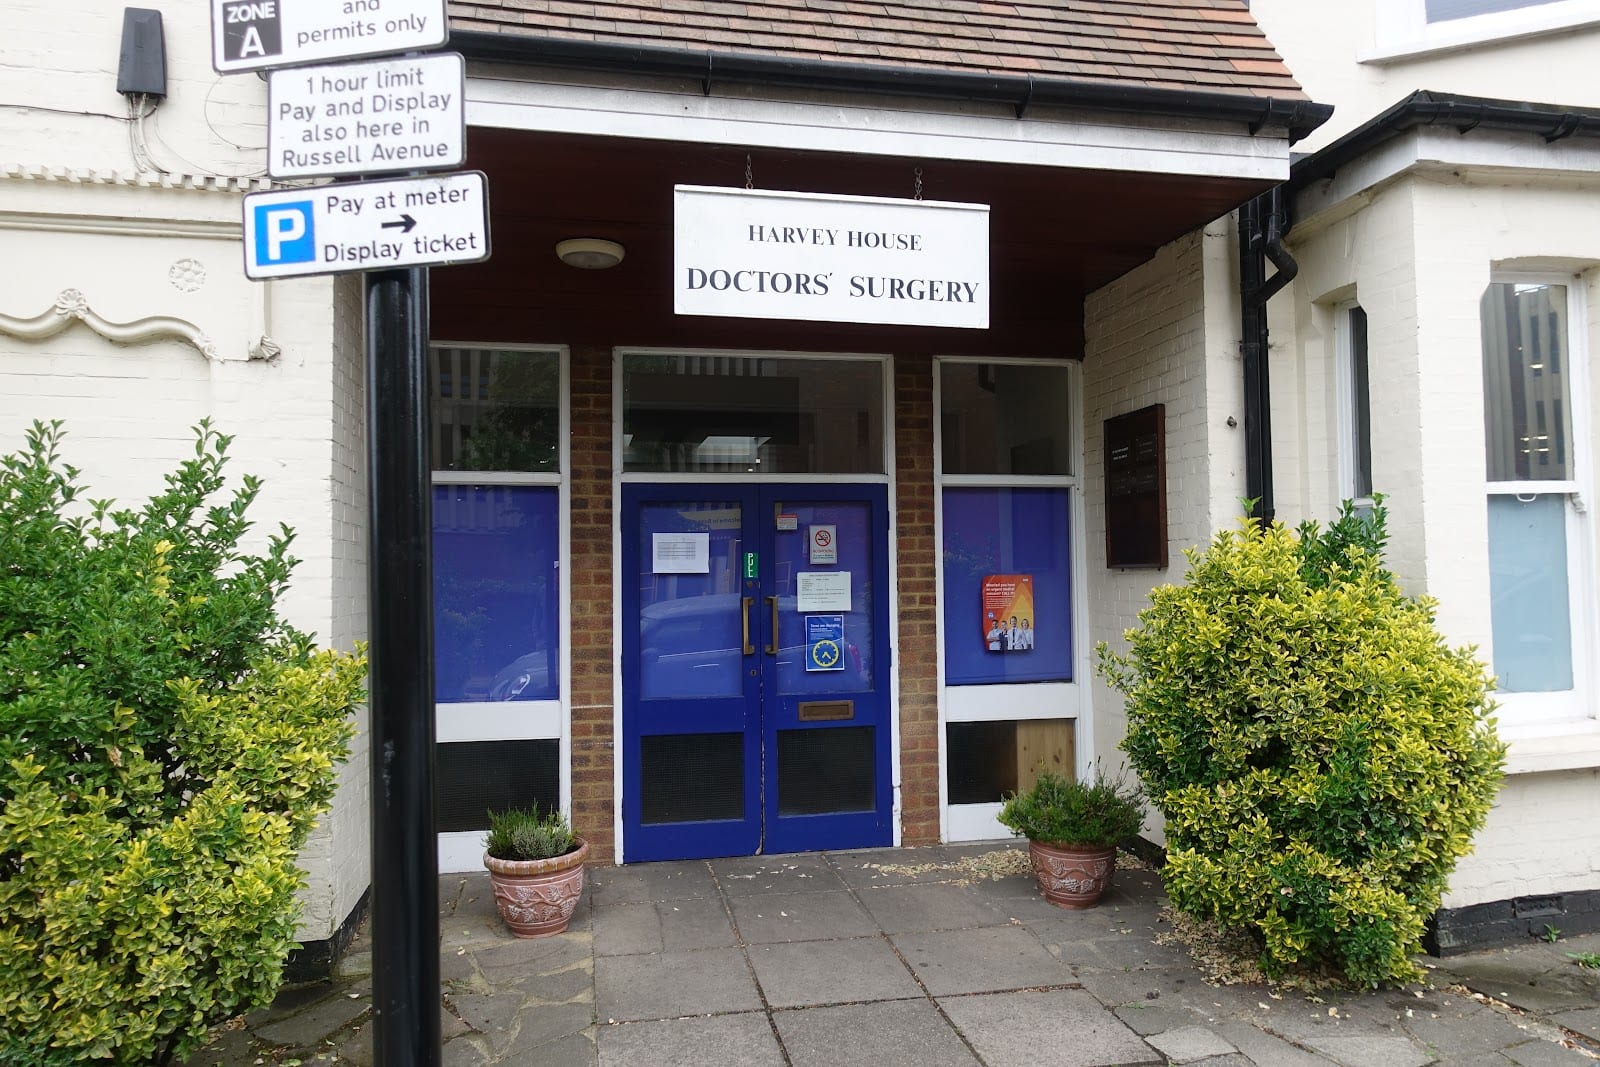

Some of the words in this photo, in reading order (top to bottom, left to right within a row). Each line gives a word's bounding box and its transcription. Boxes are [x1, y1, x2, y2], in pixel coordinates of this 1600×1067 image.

[227, 2, 276, 23] ZONE
[343, 0, 381, 15] and
[240, 27, 266, 58] A
[297, 21, 376, 48] permits
[385, 14, 427, 34] only
[306, 77, 314, 95] 1
[321, 76, 369, 94] hour
[376, 69, 425, 89] limit
[279, 103, 316, 122] Pay
[326, 97, 364, 117] and
[372, 91, 452, 113] Display
[302, 125, 348, 143] also
[356, 119, 403, 138] here
[412, 117, 430, 135] in
[282, 145, 361, 168] Russell
[371, 141, 449, 163] Avenue
[326, 196, 364, 215] Pay
[375, 192, 396, 210] at
[405, 187, 470, 208] meter
[266, 208, 306, 261] P
[324, 240, 403, 264] Display
[414, 232, 478, 255] ticket
[748, 224, 839, 247] HARVEY
[847, 230, 923, 252] HOUSE
[849, 275, 980, 304] SURGERY
